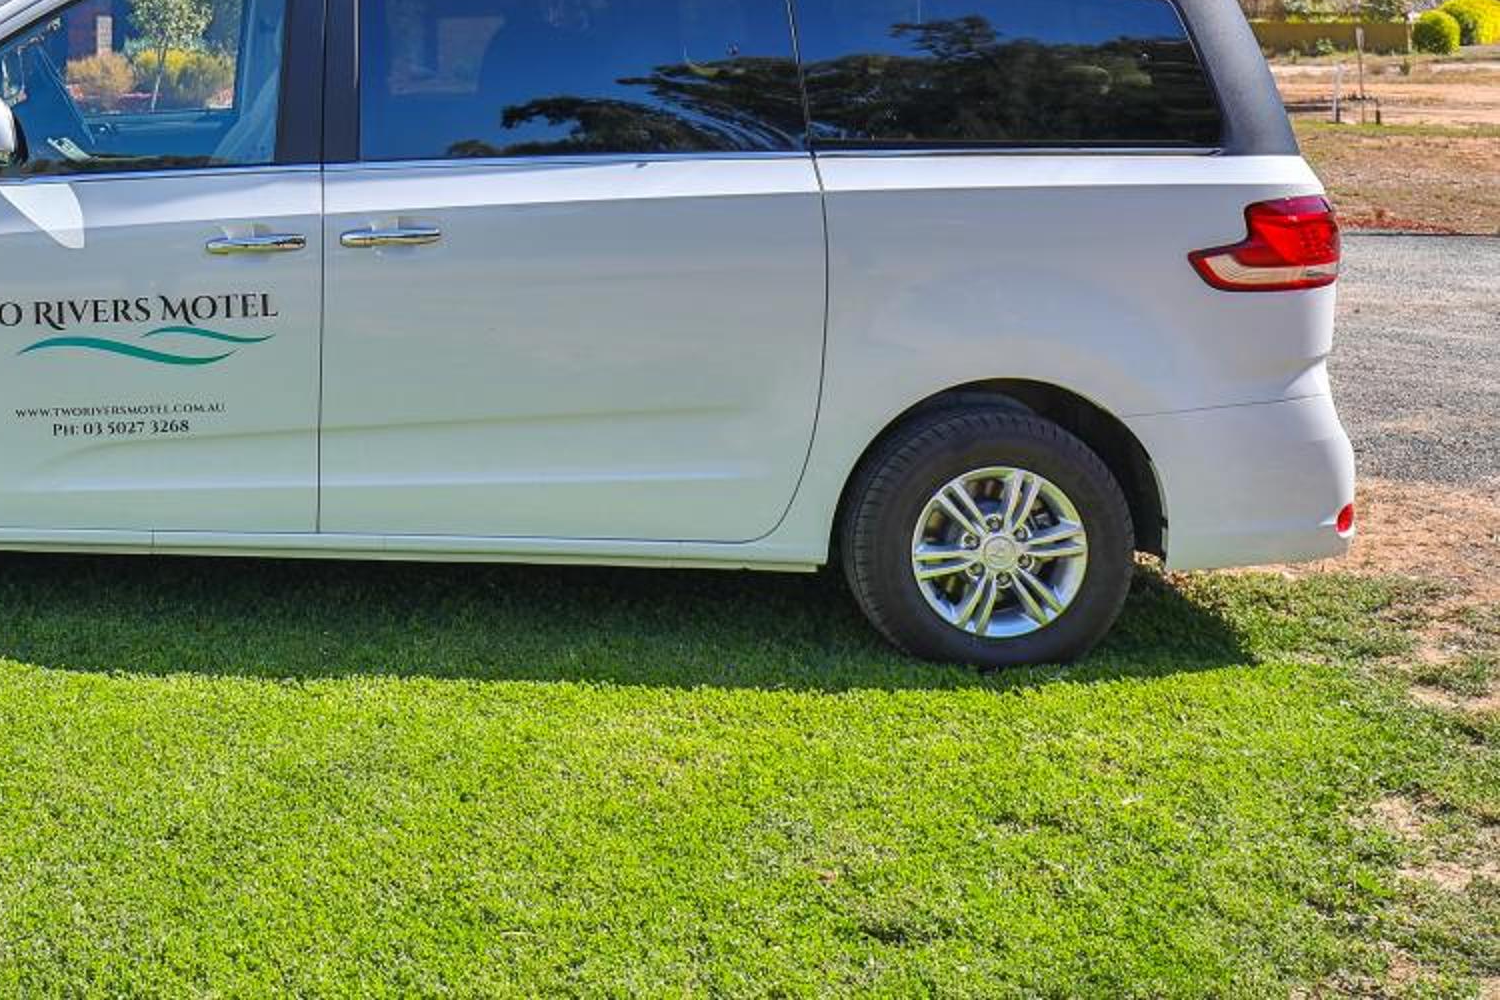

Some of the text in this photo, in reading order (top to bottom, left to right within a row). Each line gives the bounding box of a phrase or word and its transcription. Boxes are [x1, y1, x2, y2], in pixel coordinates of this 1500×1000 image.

[33, 297, 150, 330] RIVERS
[158, 293, 278, 325] MOTEL
[83, 422, 102, 435] 03
[106, 421, 145, 434] 5027
[150, 419, 189, 433] 3268
